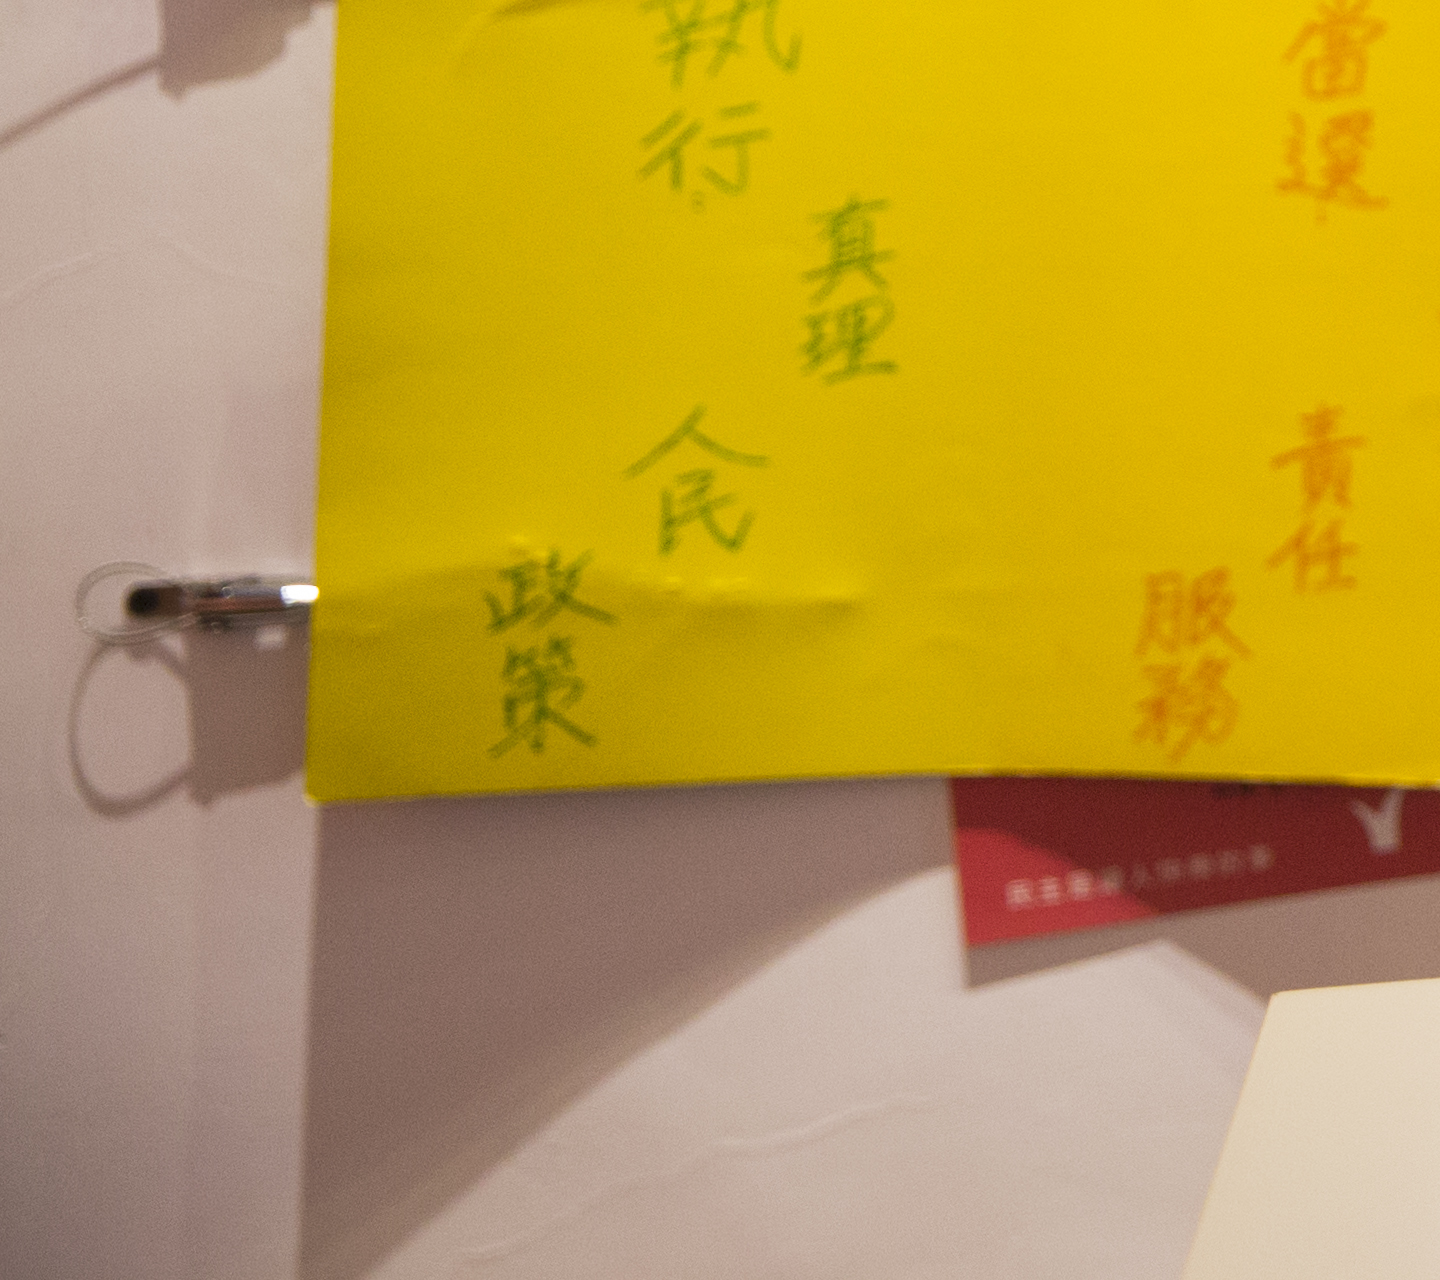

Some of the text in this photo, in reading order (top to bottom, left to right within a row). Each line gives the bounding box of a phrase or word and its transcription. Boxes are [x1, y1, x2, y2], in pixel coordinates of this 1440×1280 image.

[798, 192, 898, 386] 真理
[619, 404, 771, 558] 人民
[1263, 402, 1370, 594] 責任
[483, 544, 620, 760] 政策
[1131, 564, 1255, 766] 服務
